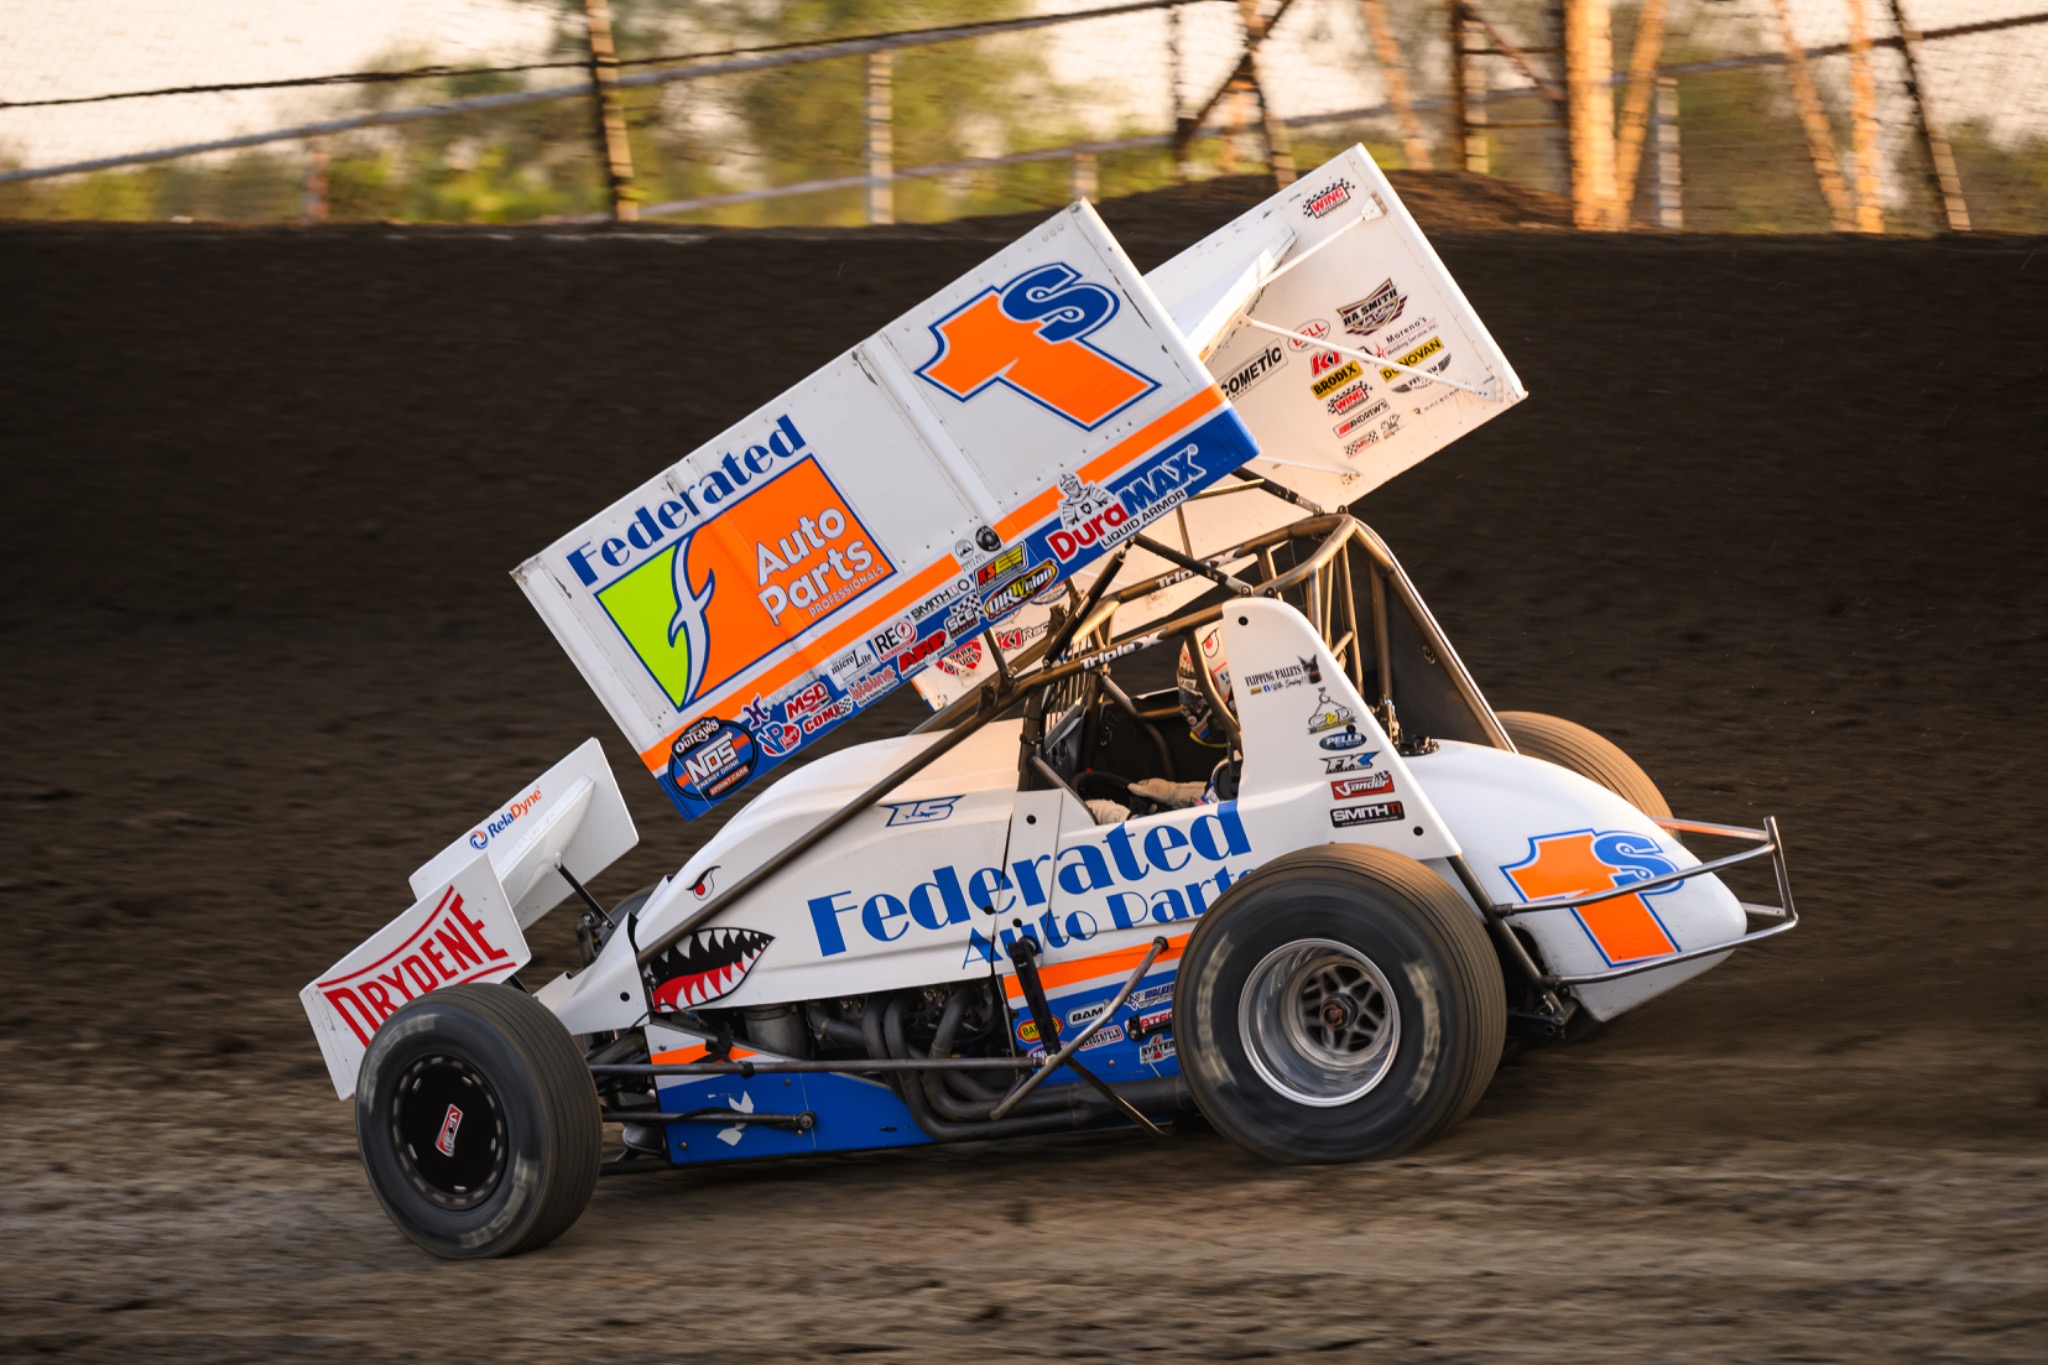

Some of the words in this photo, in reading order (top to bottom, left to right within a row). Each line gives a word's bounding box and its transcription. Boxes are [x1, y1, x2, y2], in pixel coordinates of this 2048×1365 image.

[1361, 287, 1398, 316] SMITH
[1386, 316, 1427, 344] Moreno's
[1220, 346, 1282, 397] COMETIC
[1313, 363, 1357, 395] BRODIX
[1335, 388, 1364, 410] WING
[566, 414, 806, 587] Federated
[1101, 519, 1141, 548] LIQUID
[1143, 490, 1186, 523] ARMOR
[757, 508, 846, 587] Auto
[758, 540, 874, 626] Parts
[809, 564, 886, 618] PROFESSIONALS
[947, 608, 975, 632] SCE
[900, 631, 947, 673] ARP
[1080, 642, 1130, 670] Triple
[1245, 670, 1275, 687] FLIPPING
[1275, 664, 1303, 680] PALLETS
[786, 683, 828, 719] MSD
[685, 730, 738, 785] NOS
[757, 722, 788, 755] VP
[488, 788, 543, 838] RelaDyne
[808, 801, 1252, 957] Federated
[962, 905, 1099, 970] Auto
[323, 893, 510, 1049] DRYDENE
[1072, 1007, 1104, 1022] BAM
